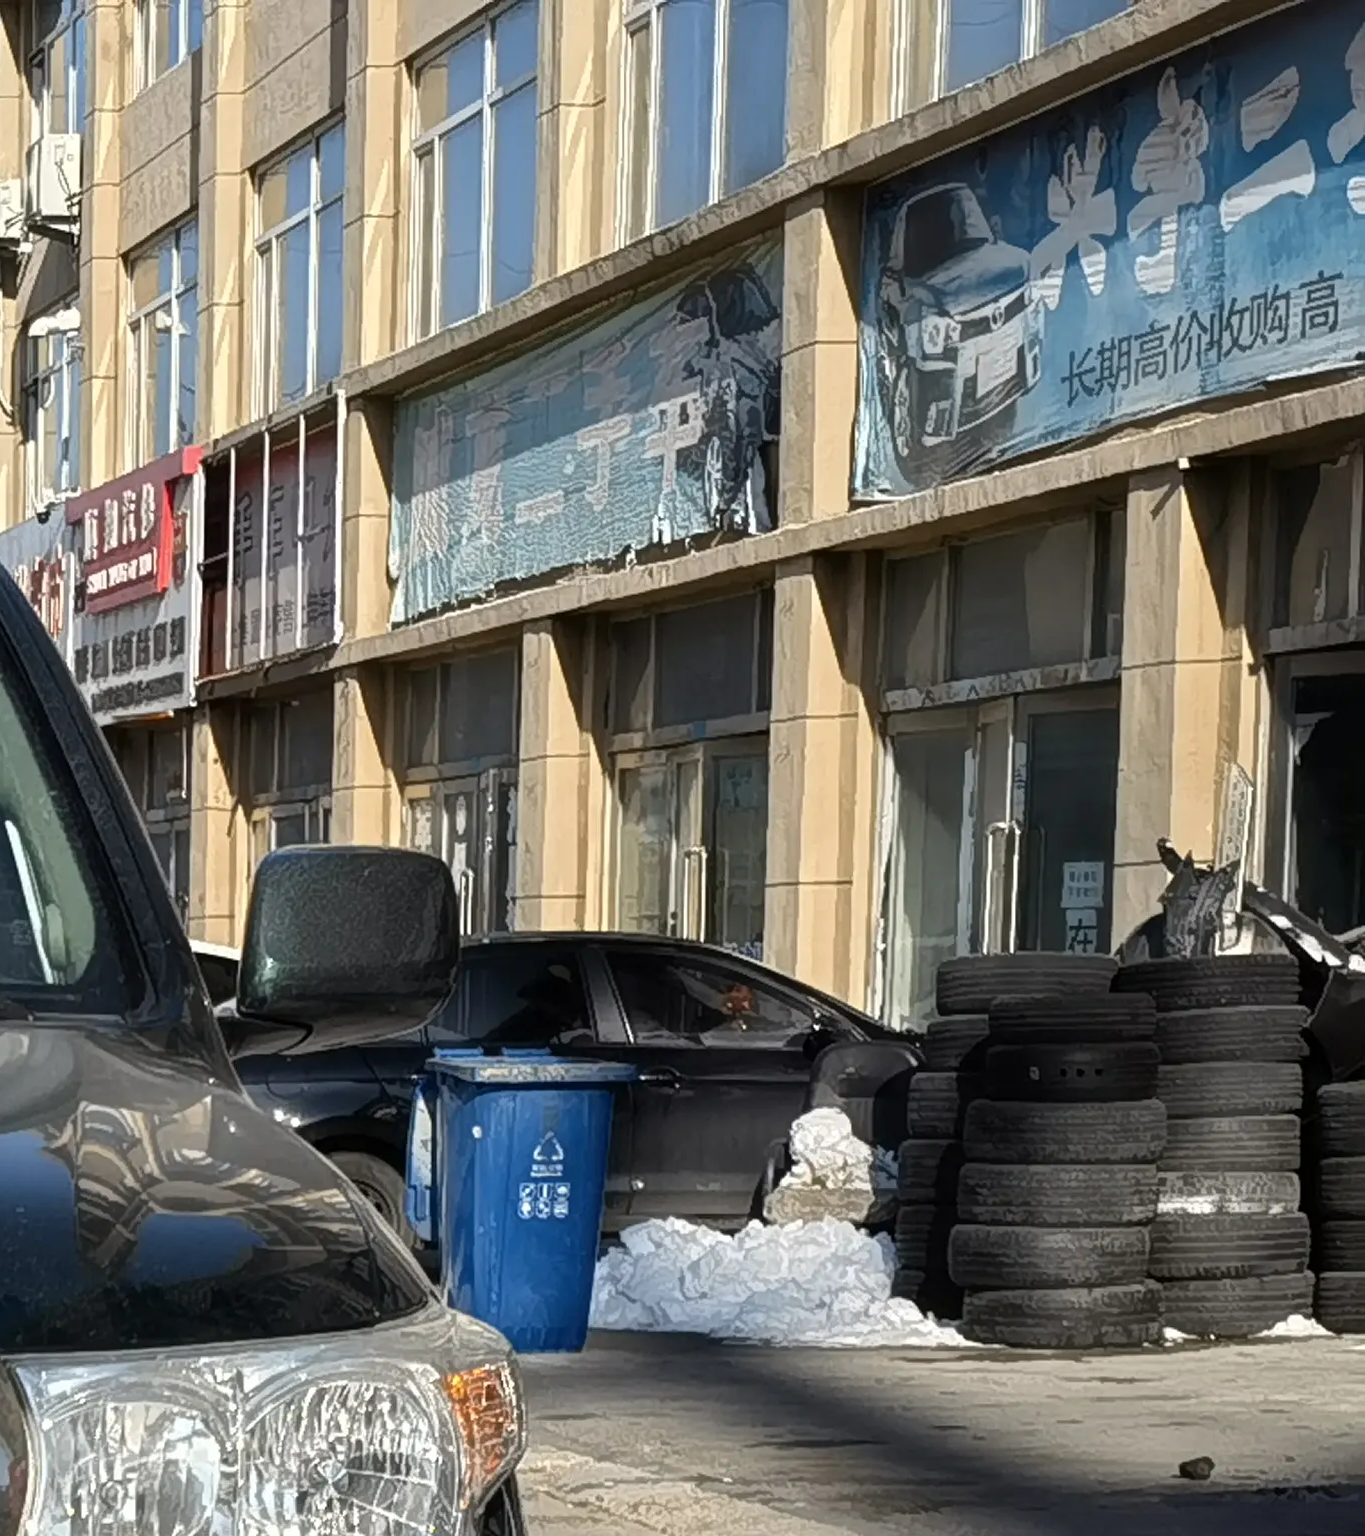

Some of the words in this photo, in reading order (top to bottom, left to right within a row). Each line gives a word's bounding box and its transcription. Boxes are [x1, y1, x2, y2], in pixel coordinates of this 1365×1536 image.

[1060, 268, 1344, 404] 长期高价收购高
